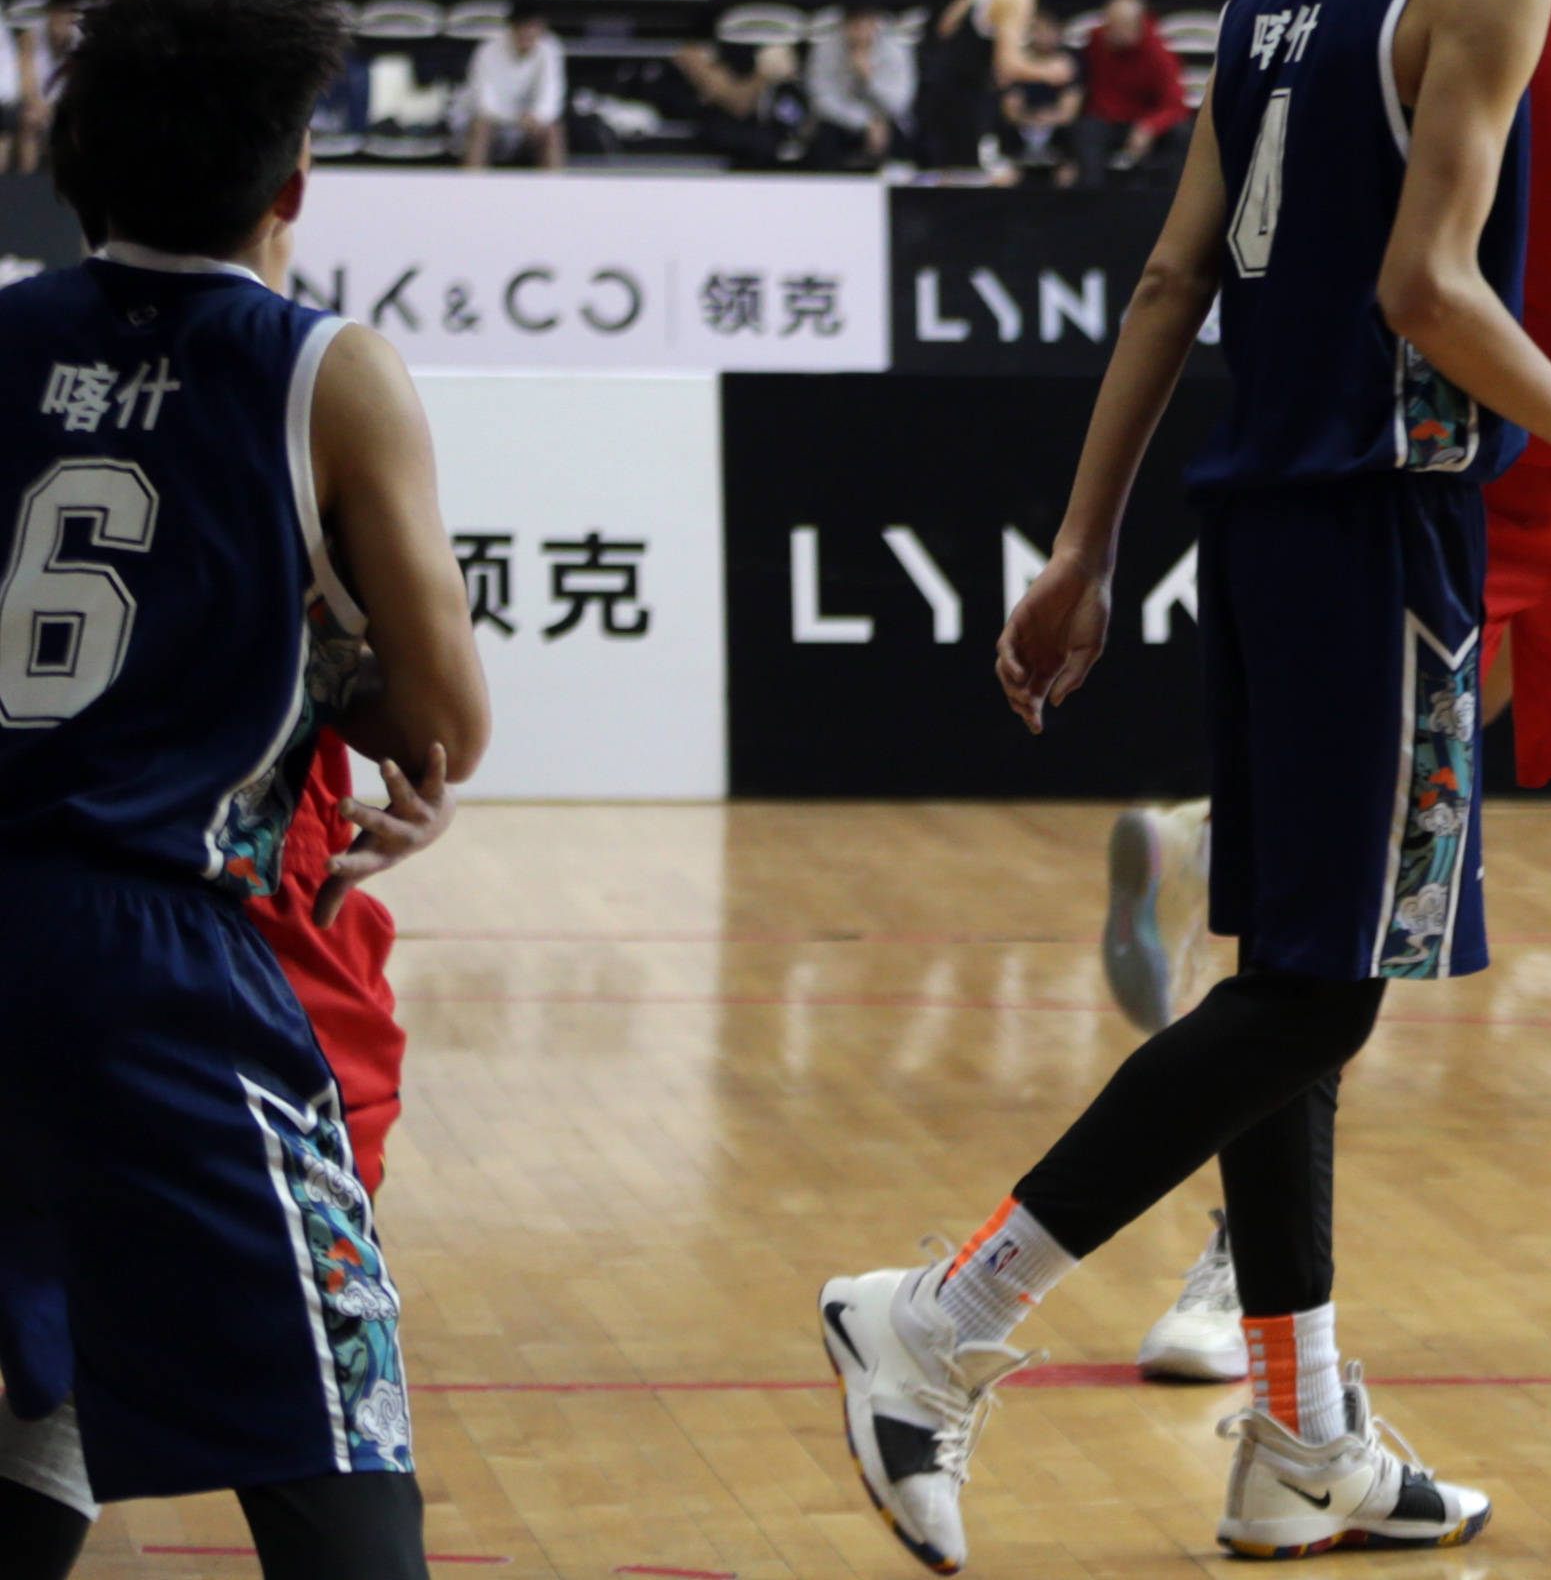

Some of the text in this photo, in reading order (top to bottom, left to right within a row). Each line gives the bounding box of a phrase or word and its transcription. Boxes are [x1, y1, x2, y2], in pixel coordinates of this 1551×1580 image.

[286, 266, 846, 339] NK&CO 领克
[40, 356, 182, 433] 喀什
[0, 456, 160, 730] 6
